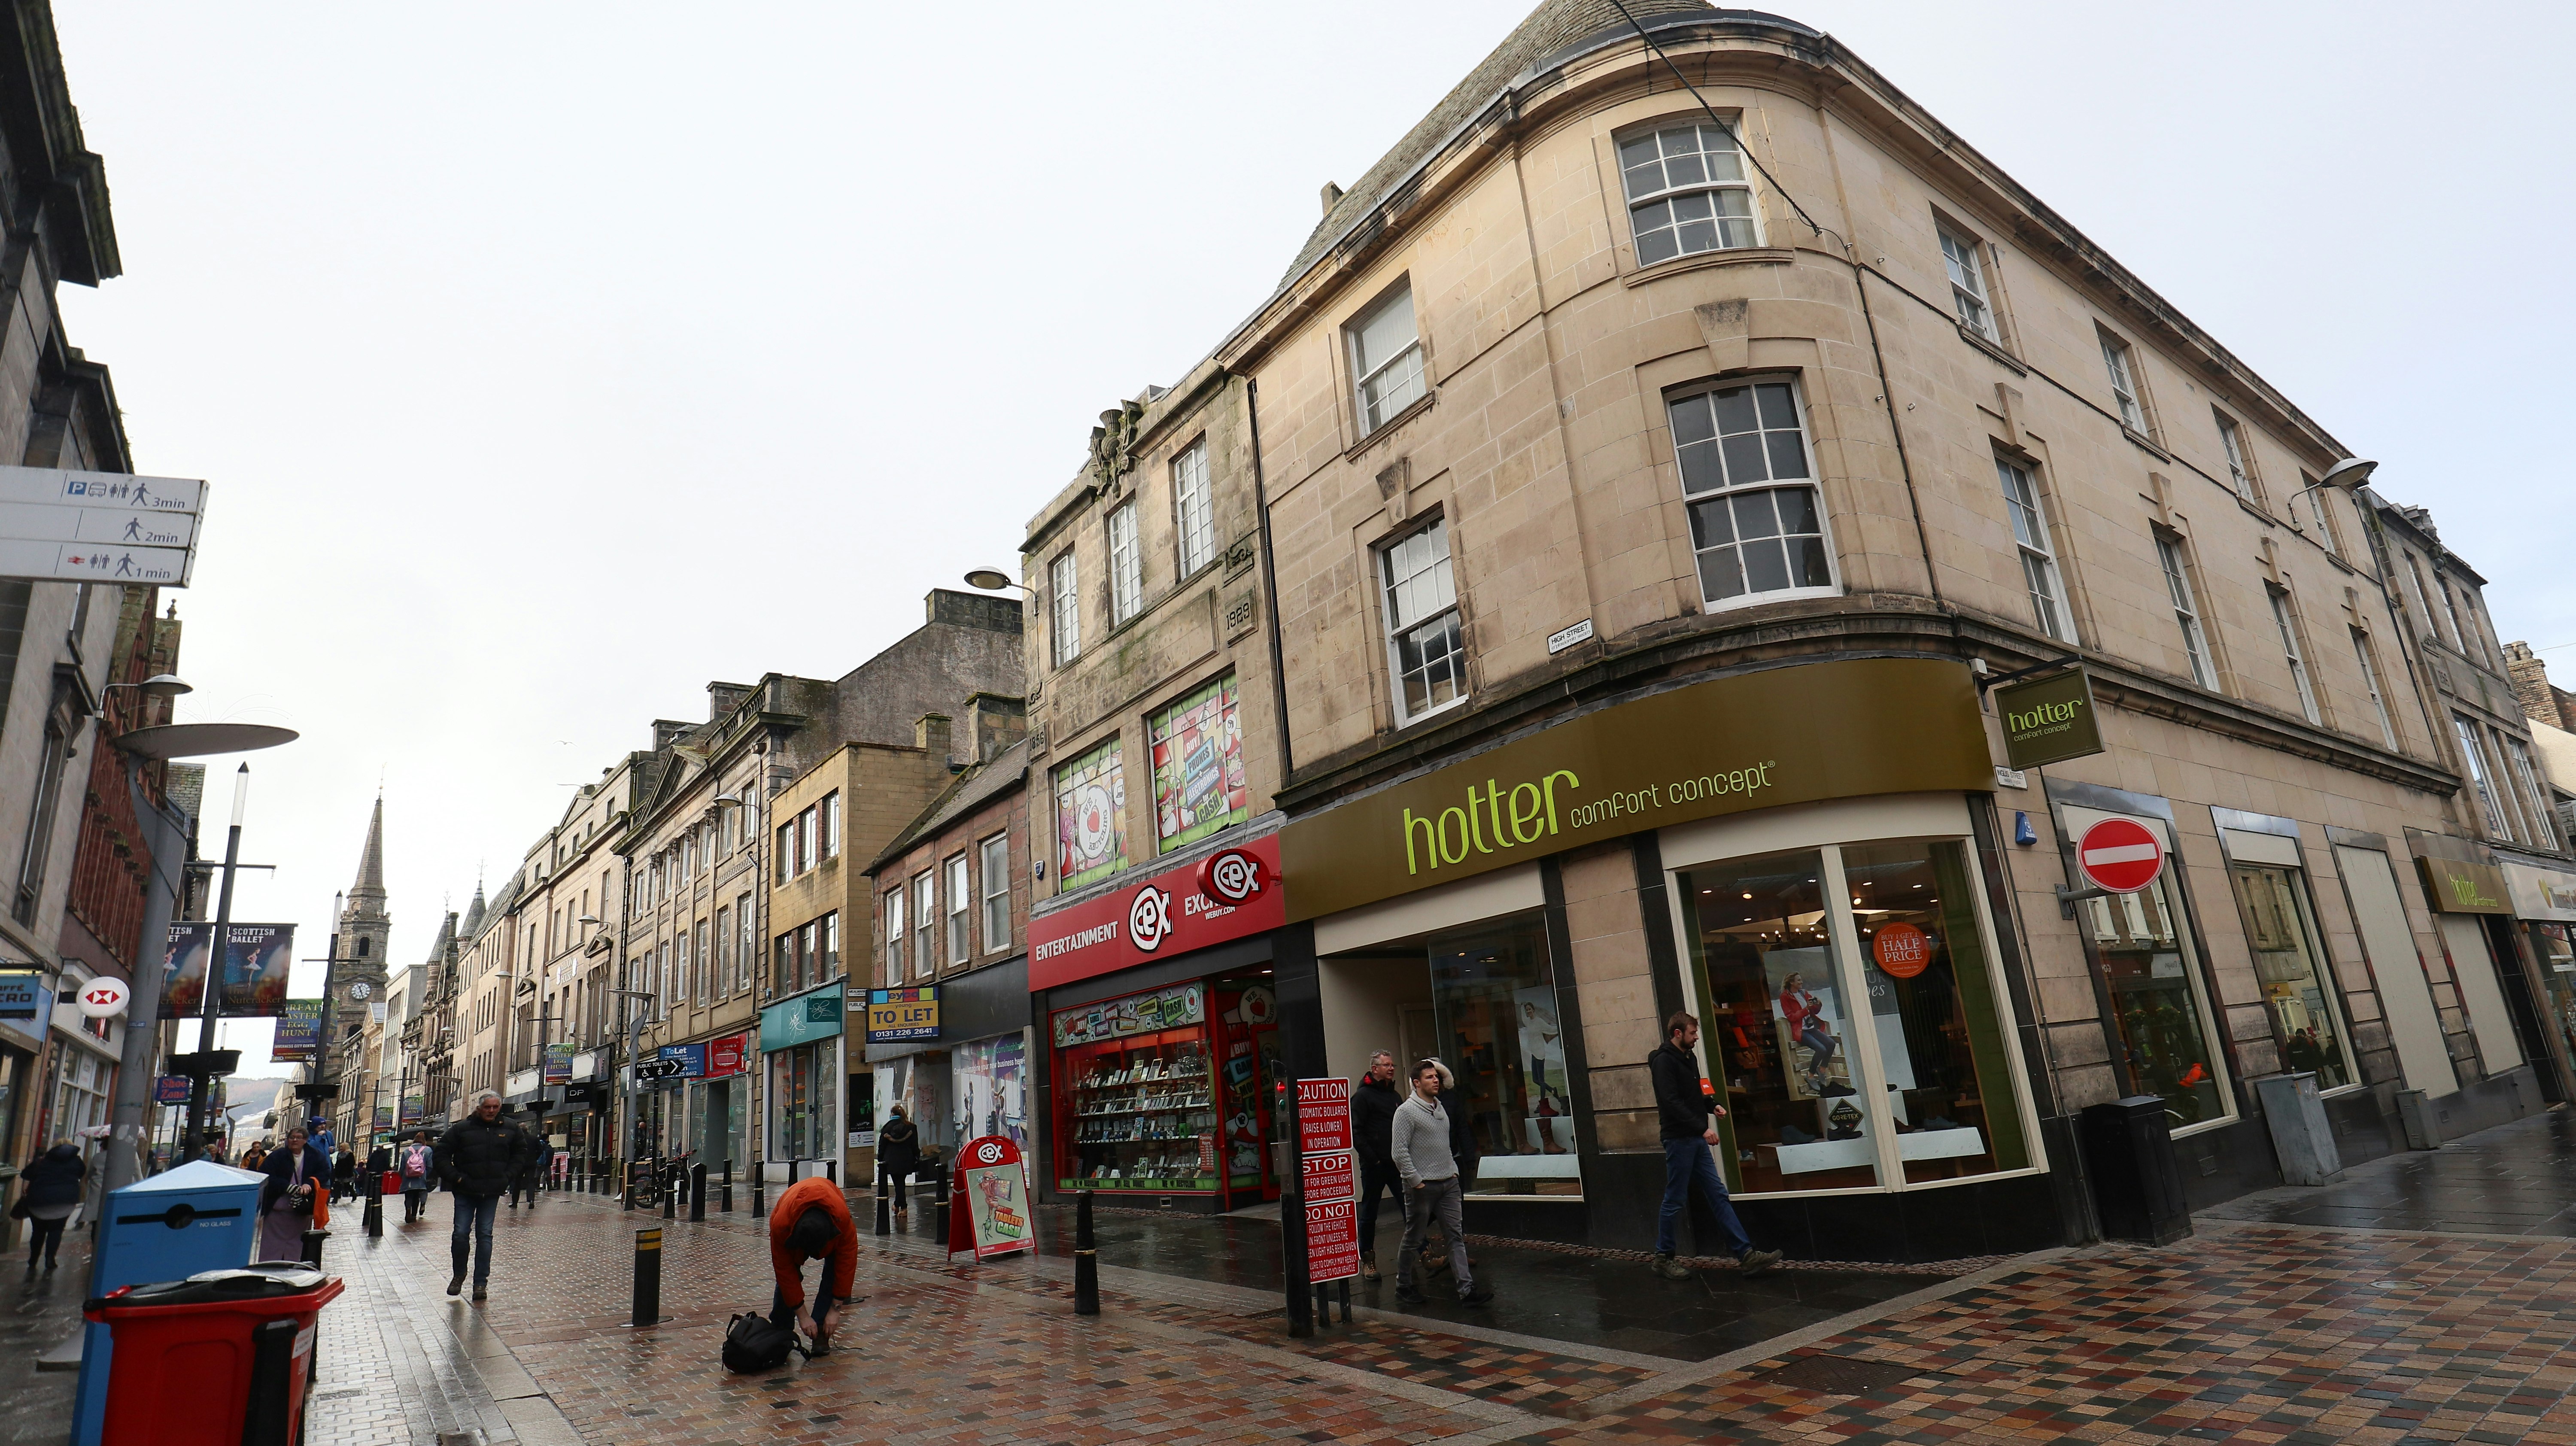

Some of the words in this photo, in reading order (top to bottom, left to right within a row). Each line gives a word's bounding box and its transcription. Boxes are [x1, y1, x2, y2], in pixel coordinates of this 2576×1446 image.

[152, 497, 185, 509] 3min
[145, 531, 178, 543] 2min
[1226, 602, 1250, 630] 1929
[1551, 634, 1565, 645] HIGH
[1566, 623, 1588, 638] STREET
[2008, 699, 2083, 732] hotter
[1030, 731, 1044, 751] 1856
[2014, 729, 2043, 742] comfort
[1188, 747, 1210, 772] PHONES
[2010, 772, 2023, 780] STREET
[1187, 766, 1220, 801] ELECTRONICS
[1083, 797, 1093, 815] WE
[1199, 796, 1220, 821] CASH
[1403, 769, 1580, 875] hotter
[1570, 784, 1663, 829] comfort
[1204, 906, 1236, 920] WEBUY.COM
[169, 927, 192, 935] TISH
[232, 928, 275, 936] SCOTTISH
[1036, 920, 1118, 961] ENTERTAINMENT
[1882, 938, 1919, 952] HALF
[1884, 949, 1922, 962] PRICE
[227, 996, 282, 1005] Nutcracker
[1245, 990, 1257, 1002] WE
[1166, 1000, 1182, 1017] CASH
[874, 1010, 896, 1024] TO
[904, 1008, 933, 1022] LET
[967, 1065, 981, 1074] imagine
[997, 1060, 1014, 1068] business
[162, 1078, 187, 1088] Shoe
[160, 1089, 186, 1099] Zone
[1297, 1083, 1346, 1100] CAUTION
[1299, 1106, 1322, 1118] UTOMATIC
[1324, 1106, 1347, 1117] BOLLARDS
[1303, 1122, 1320, 1134] (RAISE
[1320, 1122, 1324, 1132] &
[1324, 1120, 1342, 1132] LOWER)
[1307, 1139, 1313, 1149] IN
[1314, 1136, 1340, 1148] OPERATION
[1303, 1157, 1348, 1173] STOP
[1310, 1178, 1320, 1187] FOR
[1321, 1175, 1337, 1185] GREEN
[1338, 1173, 1352, 1183] LIGHT
[1304, 1189, 1319, 1199] EFORE
[1320, 1185, 1351, 1197] PROCEEDING
[995, 1211, 1024, 1226] TABLETS
[1306, 1208, 1321, 1221] DO
[1325, 1203, 1351, 1218] NOT
[996, 1222, 1021, 1238] CASH
[1309, 1223, 1323, 1234] FOLLOW
[1331, 1220, 1347, 1230] VEHICLE
[1309, 1236, 1313, 1246] IN
[1314, 1234, 1326, 1245] FRONT
[1326, 1232, 1340, 1243] UNLESS
[1315, 1246, 1326, 1257] LIGHT
[1335, 1243, 1345, 1253] BEEN
[1345, 1241, 1356, 1252] GIVEN
[1310, 1261, 1318, 1270] LURE
[1324, 1258, 1337, 1267] COMPLY
[1345, 1255, 1357, 1264] RESULT
[1313, 1269, 1327, 1279] DAMAGE
[1332, 1267, 1342, 1275] YOUR
[1342, 1264, 1355, 1273] VEHICLE
